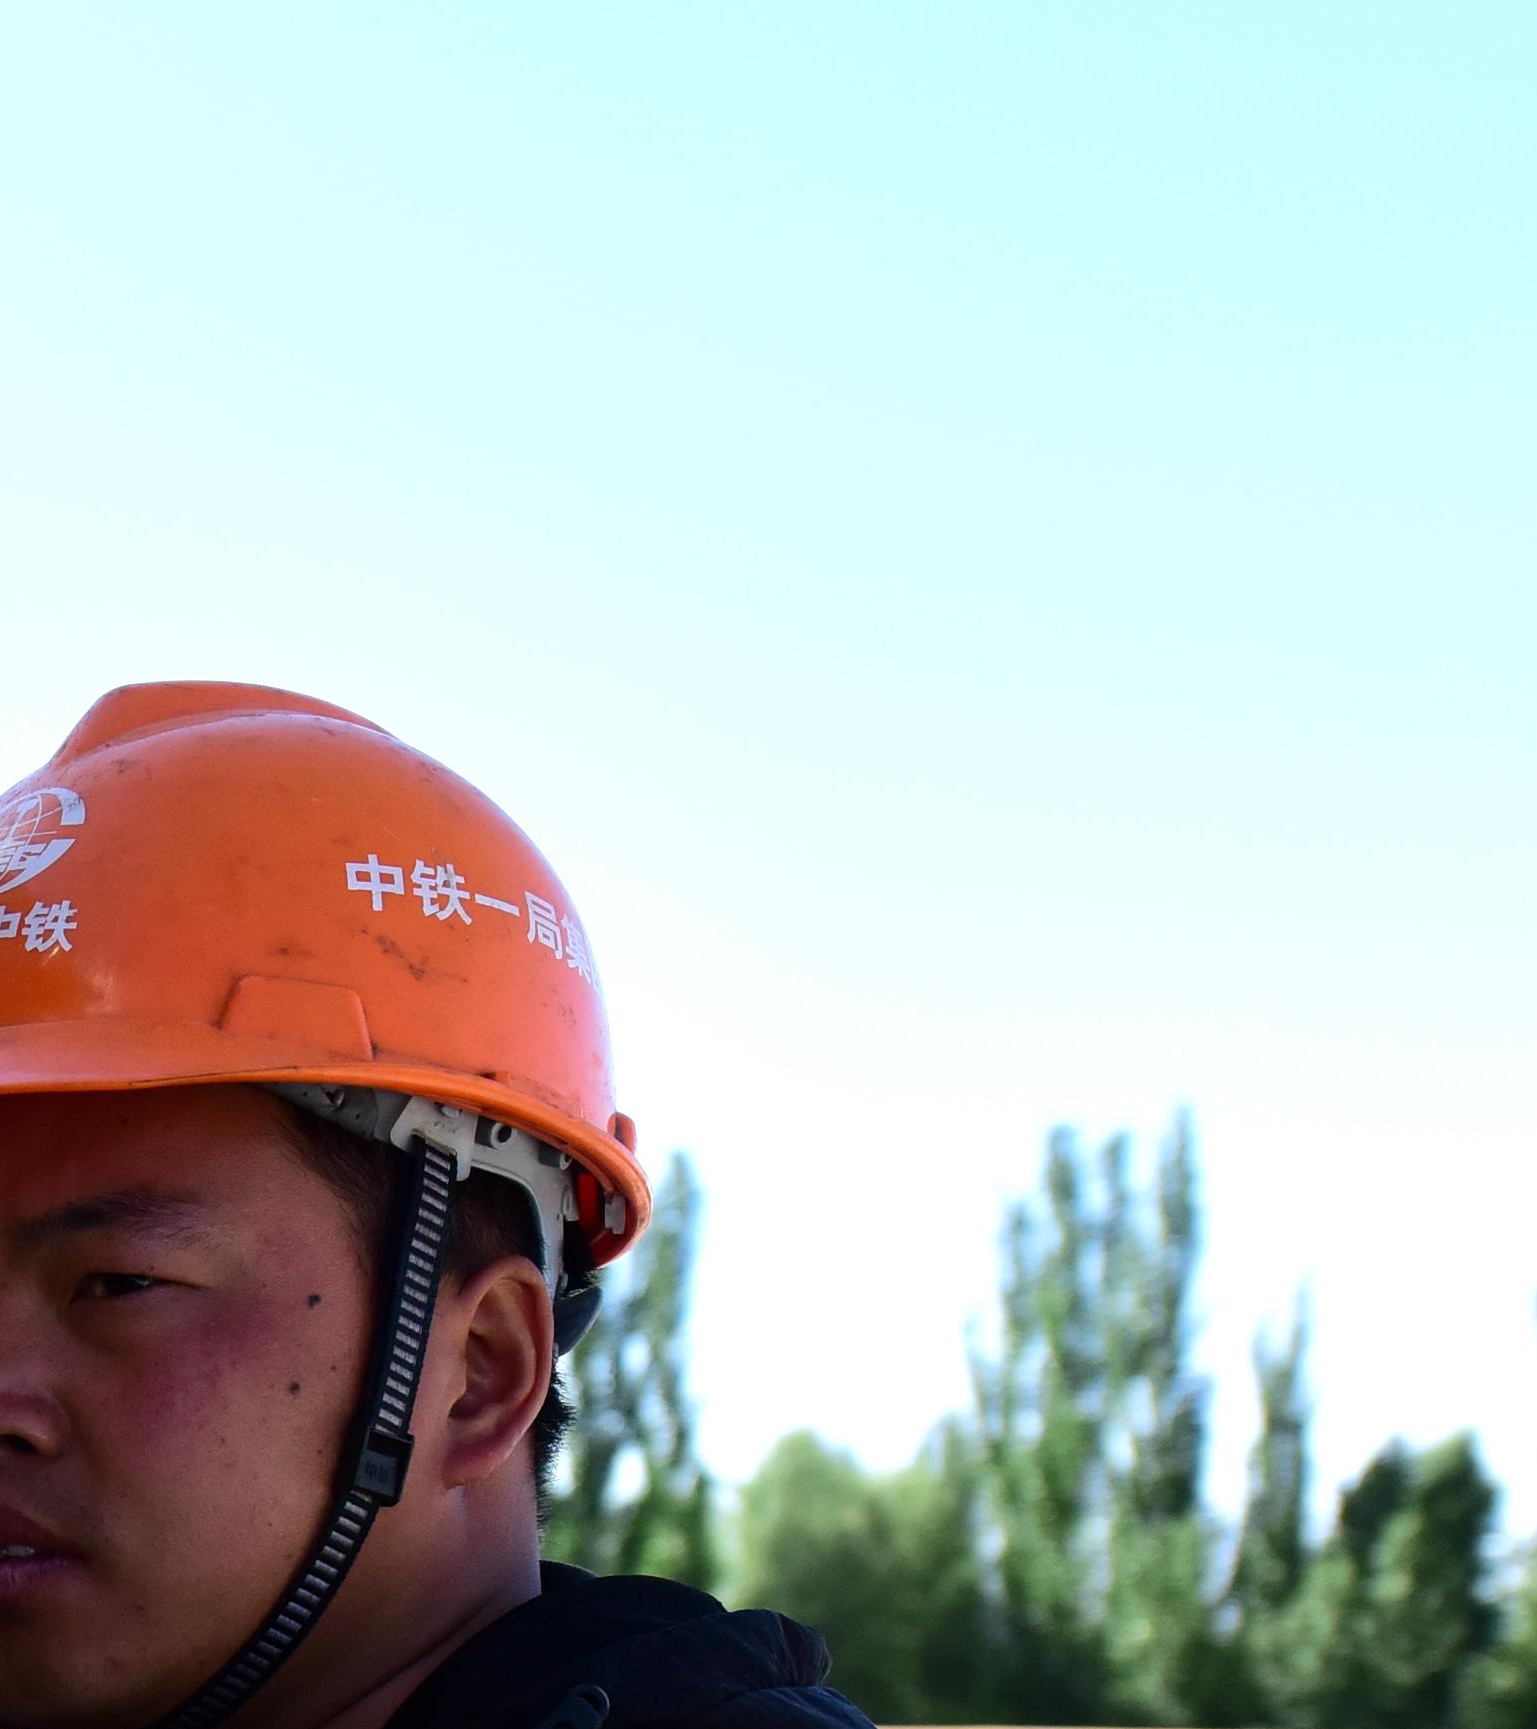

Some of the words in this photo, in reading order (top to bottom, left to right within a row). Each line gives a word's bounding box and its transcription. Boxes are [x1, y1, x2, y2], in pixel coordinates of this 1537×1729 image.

[345, 853, 598, 992] 中铁一局集
